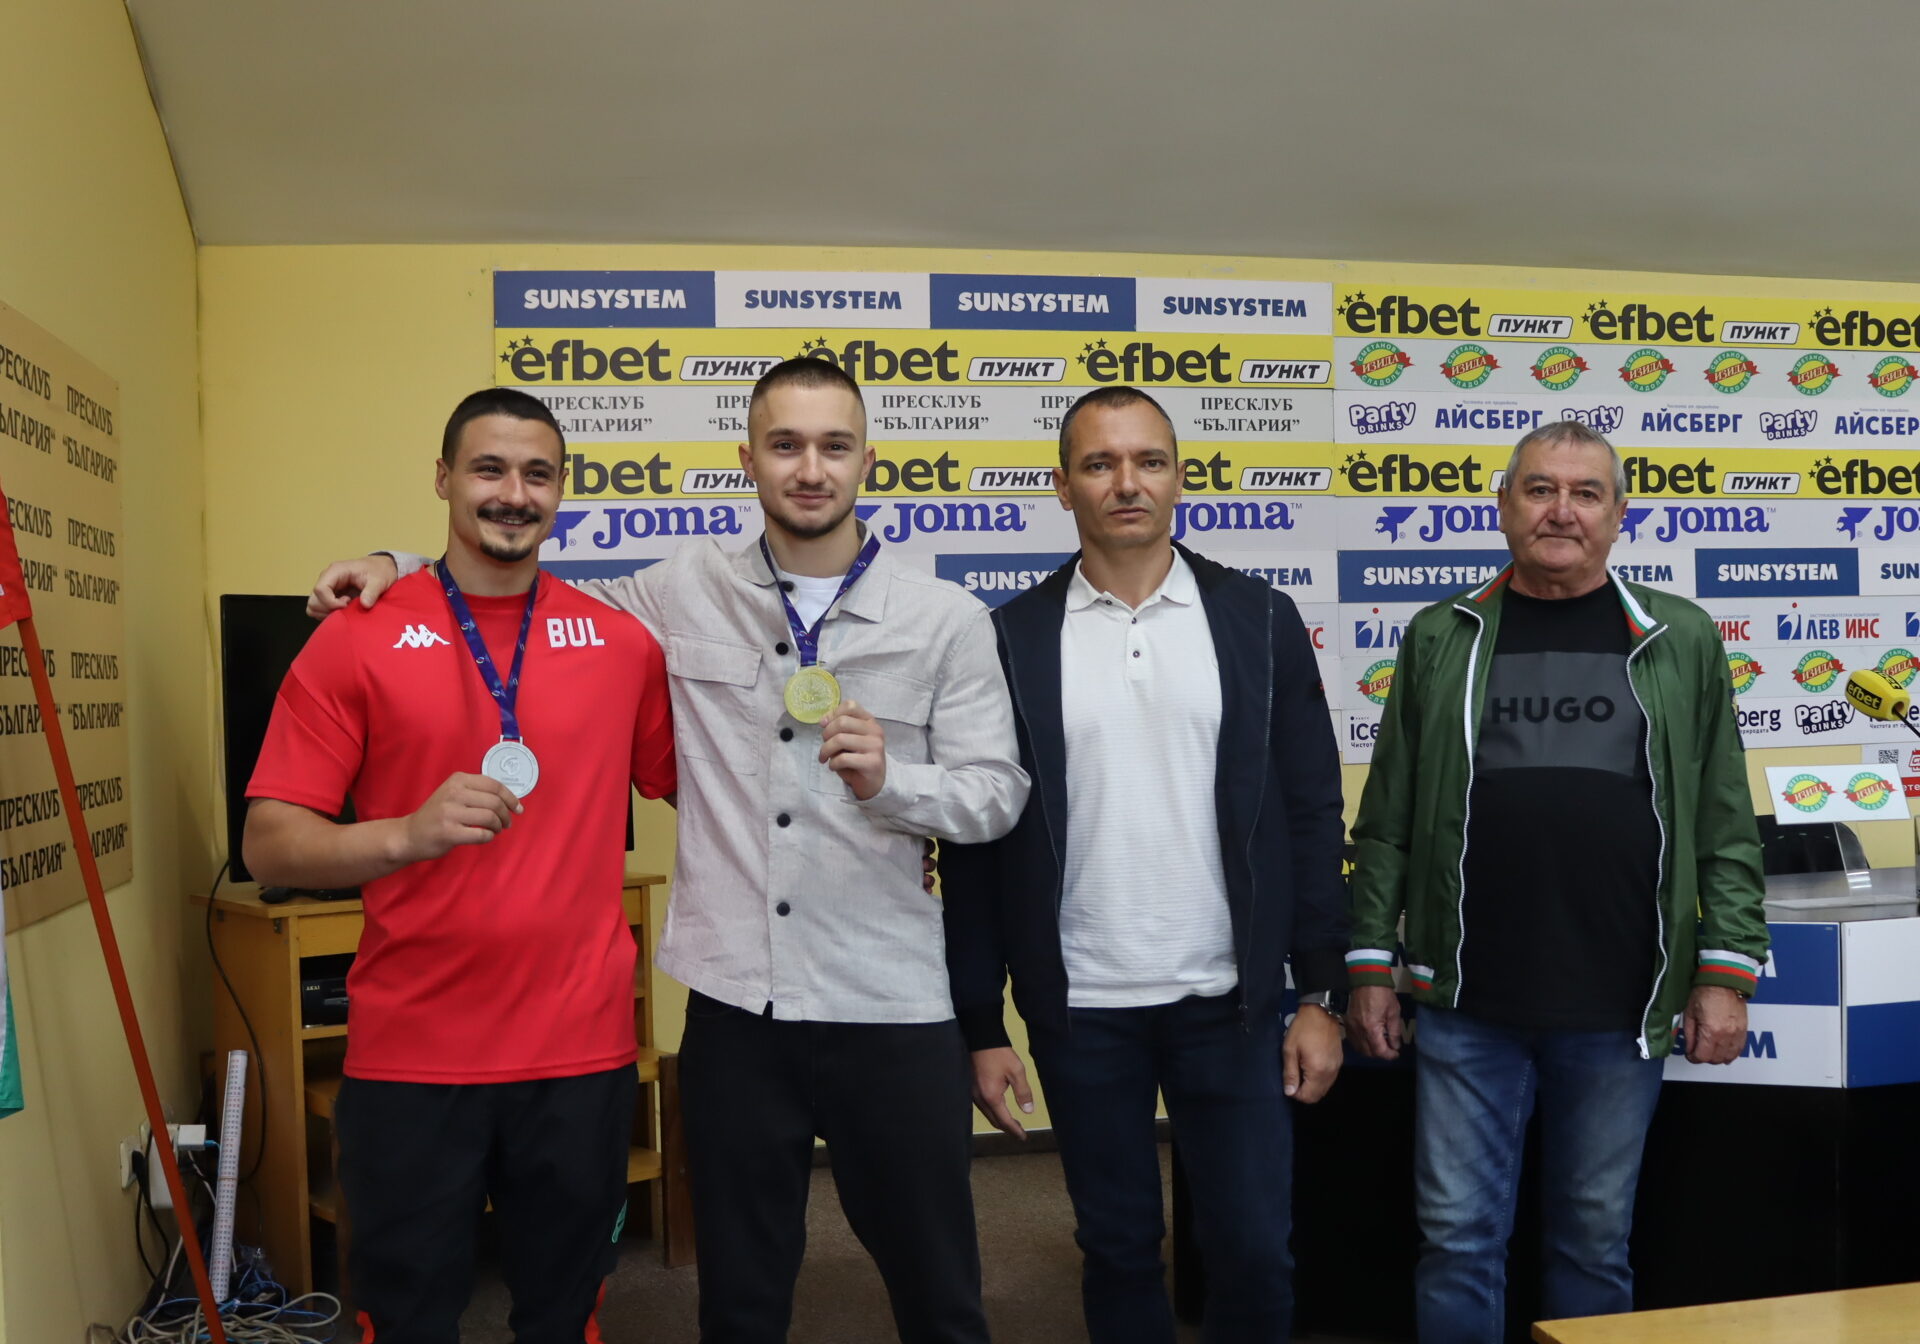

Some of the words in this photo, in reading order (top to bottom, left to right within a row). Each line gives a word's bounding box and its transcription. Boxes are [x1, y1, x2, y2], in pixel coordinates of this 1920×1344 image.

[523, 289, 687, 310] SUNSYSTEM
[744, 290, 902, 310] SUNSYSTEM
[958, 291, 1110, 314] SUNSYSTEM
[1163, 296, 1307, 318] SUNSYSTEM
[1346, 295, 1481, 336] efbet
[1497, 318, 1563, 335] ПУНКТ
[1590, 304, 1715, 343] efbet
[1730, 325, 1791, 340] ПУНКТ
[0, 344, 51, 401] РЕСКЛУБ
[510, 339, 673, 382] efbet
[692, 360, 772, 377] ПУНКТ
[978, 361, 1055, 378] ПУНКТ
[1086, 341, 1232, 383] efbet
[1250, 364, 1321, 380] ПУНКТ
[1361, 352, 1400, 373] ИЗИДА
[1450, 355, 1487, 376] ИЗИДА
[1540, 357, 1577, 378] ИЗИДА
[1629, 359, 1664, 379] ИЗИДА
[1715, 361, 1748, 381] ИЗИДА
[1797, 364, 1829, 383] ИЗИДА
[1878, 366, 1909, 385] ИЗИДА
[67, 385, 113, 436] ПРЕСКЛУБ
[541, 395, 644, 410] ПРЕСКЛУБ
[881, 395, 982, 409] ПРЕСКЛУБ
[1200, 397, 1293, 411] ПРЕСКЛУБ
[1349, 401, 1416, 427] Party
[1358, 421, 1403, 434] DRINKS
[1435, 403, 1543, 430] АЙСБЕРГ
[1561, 405, 1624, 429] Party
[1641, 408, 1743, 433] АЙСБЕРГ
[1760, 409, 1818, 433] Party
[1834, 411, 1920, 435] АЙСБЕР
[1767, 427, 1807, 440] DRINKS
[566, 452, 673, 495] bet
[692, 473, 756, 488] ПУНК
[864, 450, 961, 493] bet
[980, 471, 1055, 487] ПУНКТ
[1250, 471, 1321, 487] ПУНКТ
[1347, 453, 1483, 493] efbet
[1622, 456, 1717, 495] fbet
[1731, 476, 1791, 491] ПУНКТ
[7, 497, 52, 539] ЕСКЛУБ
[593, 505, 743, 549] Joma
[883, 502, 1027, 543] Joma
[1170, 501, 1295, 541] Joma
[1656, 505, 1770, 543] Joma
[68, 518, 115, 558] ПРЕСКЛУБ
[964, 570, 1058, 591] SUNSY
[1363, 566, 1498, 586] SUNSYSTEM
[1718, 562, 1839, 582] SUNSYSTEM
[546, 617, 606, 648] BUL
[1806, 619, 1840, 640] ЛЕВ
[1845, 618, 1880, 639] ИНС
[70, 652, 119, 680] ПРЕСКЛУБ
[1364, 661, 1398, 680] СМЕТАНО
[1732, 664, 1752, 678] ИДА
[1802, 660, 1834, 680] ИЗИДА
[1369, 675, 1393, 692] ИЗИ
[1846, 682, 1881, 710] efbet
[1491, 695, 1615, 724] HUGO
[1737, 704, 1781, 731] berg
[1795, 701, 1856, 728] Party
[1803, 721, 1844, 735] DRINKS
[76, 777, 123, 811] ПРЕСКЛУБ
[0, 789, 60, 831] ПРЕСКЛУБ
